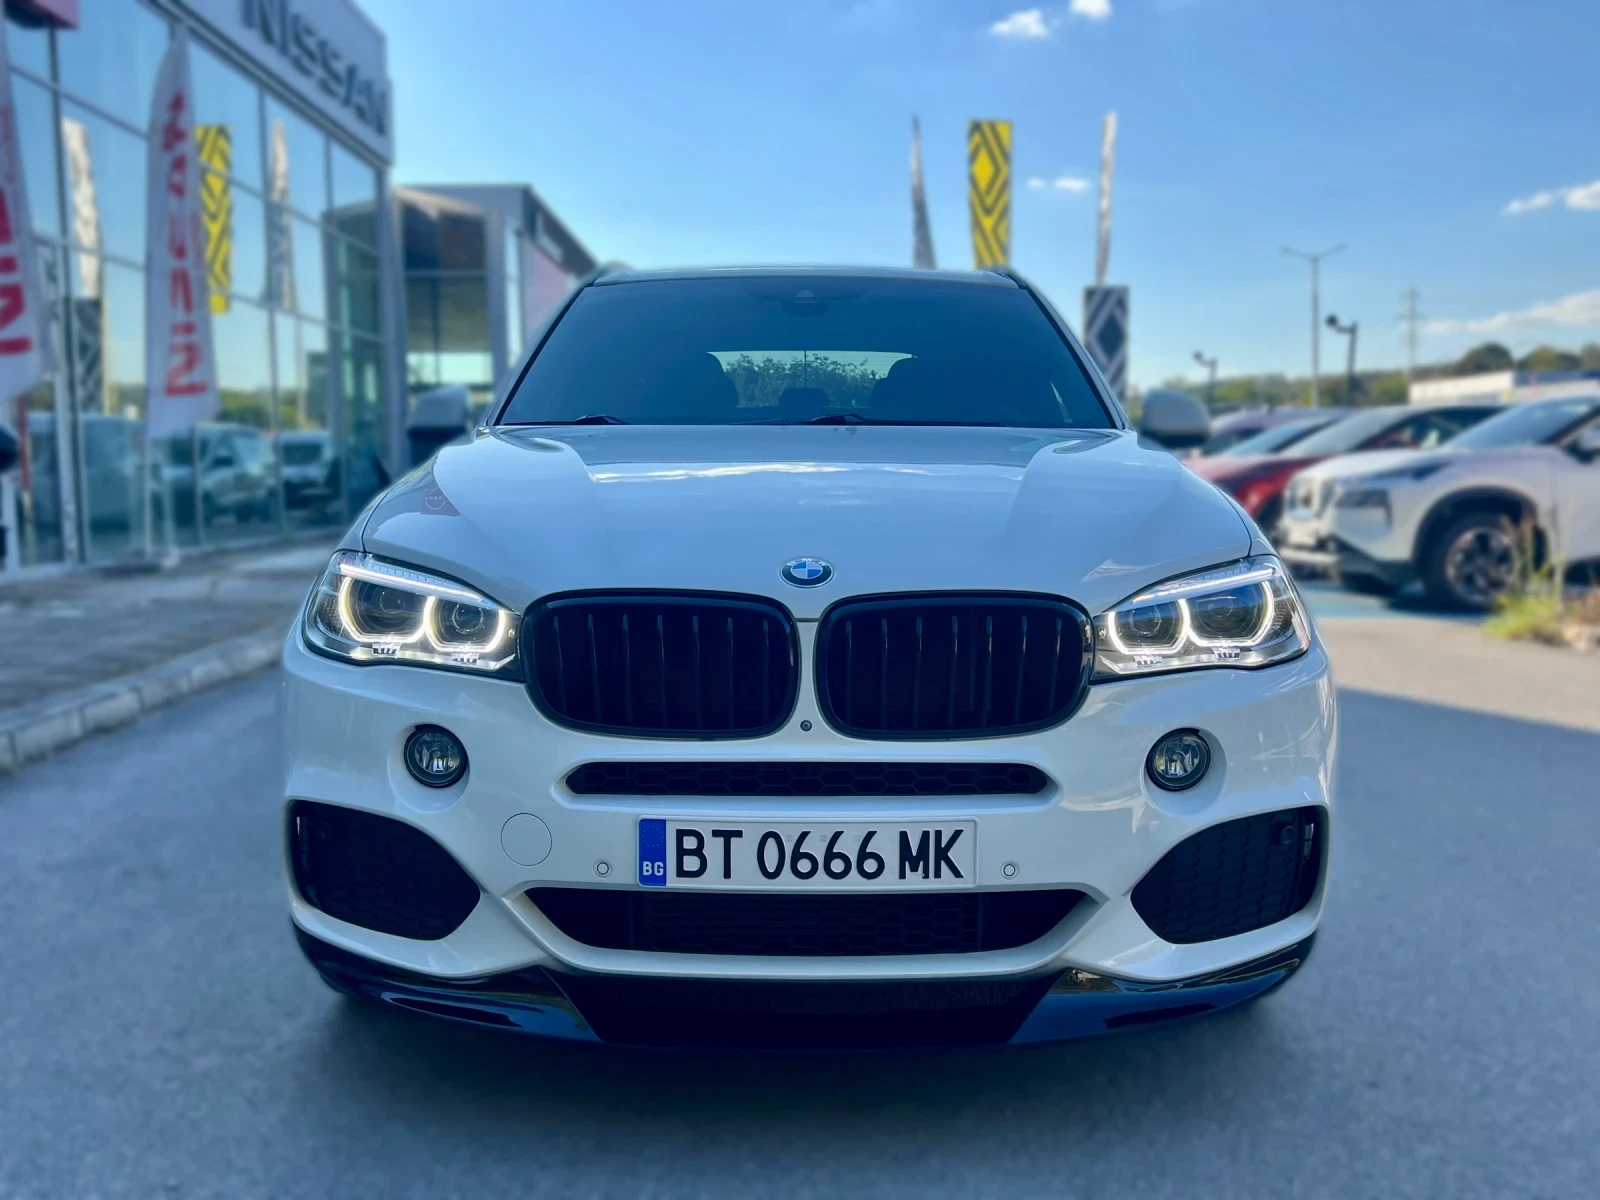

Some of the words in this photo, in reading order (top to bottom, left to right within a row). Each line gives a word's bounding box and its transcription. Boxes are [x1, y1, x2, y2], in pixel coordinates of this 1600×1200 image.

[642, 862, 665, 877] BG
[675, 828, 744, 880] BT
[756, 830, 886, 881] 0666
[898, 829, 965, 880] MK
